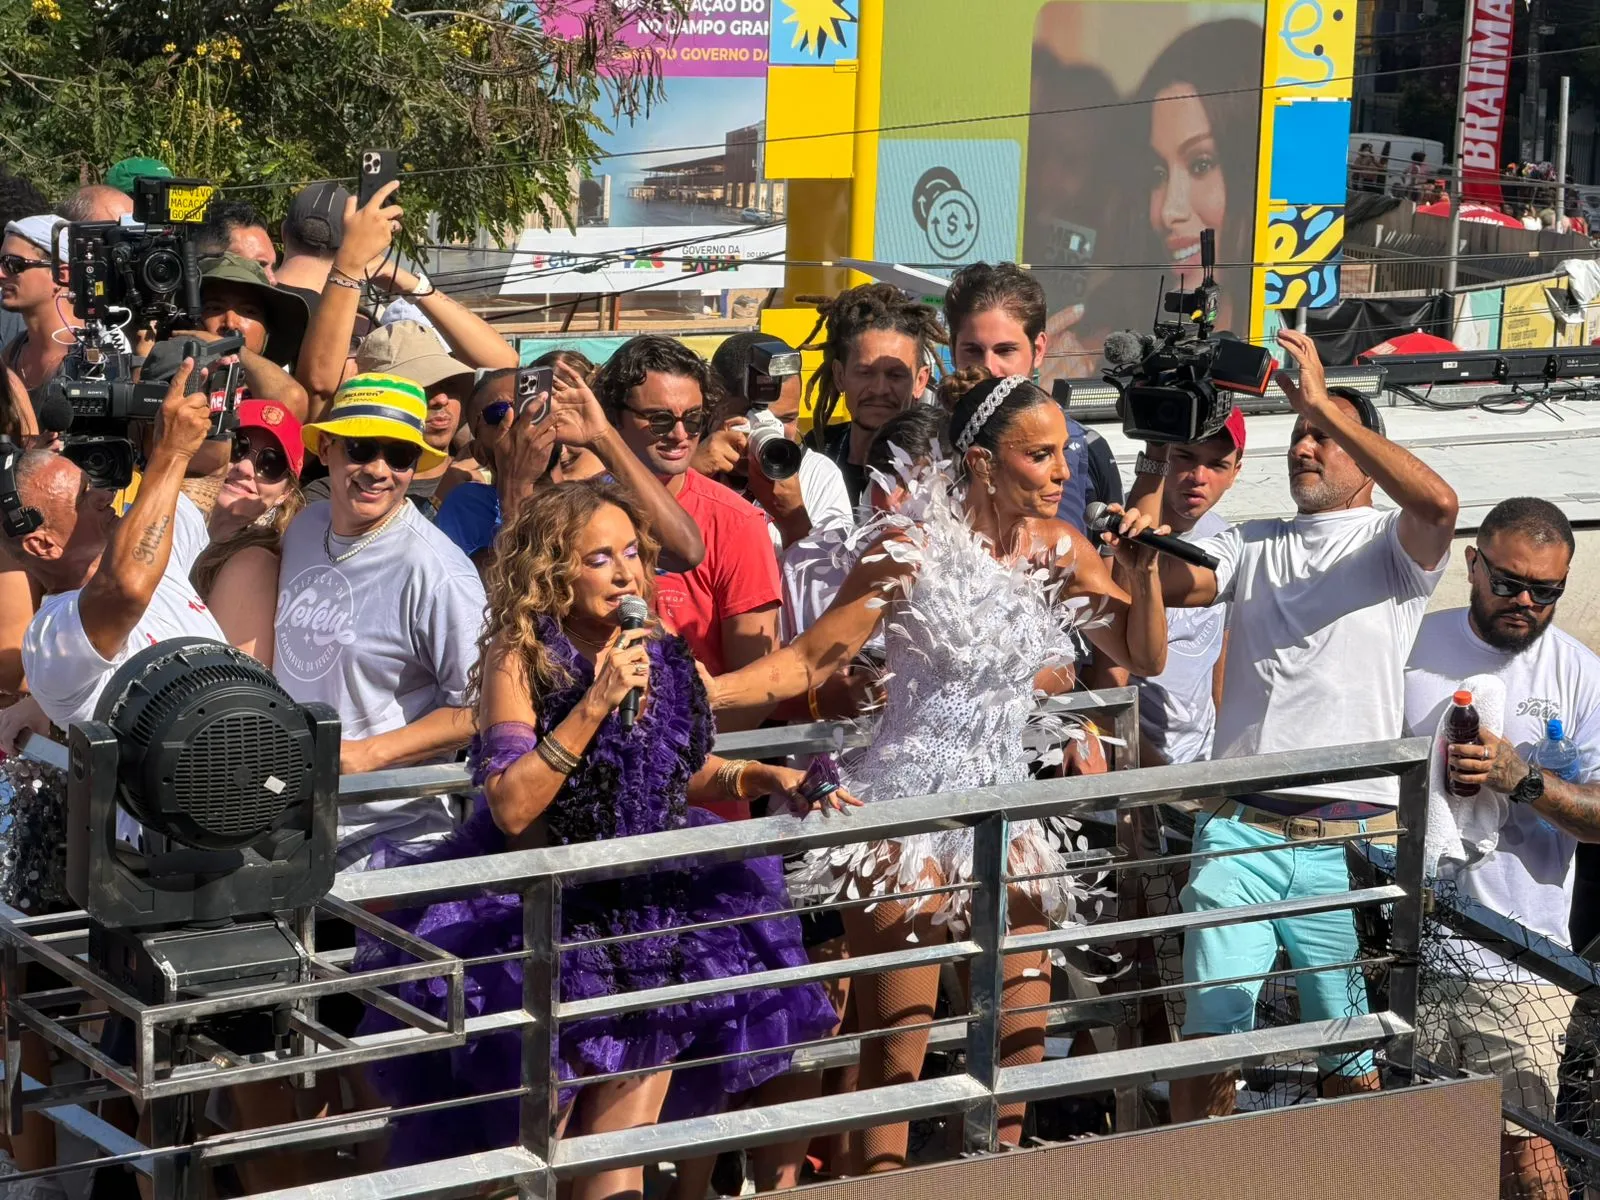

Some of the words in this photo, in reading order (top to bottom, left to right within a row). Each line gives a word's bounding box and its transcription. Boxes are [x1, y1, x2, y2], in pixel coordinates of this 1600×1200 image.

[740, 0, 765, 13] DO
[637, 19, 662, 34] NO
[665, 19, 726, 35] CAMPO
[680, 47, 750, 61] GOVERNO
[753, 48, 768, 62] DA
[1463, 0, 1513, 170] BRAHMA
[682, 245, 726, 255] GOVERNO
[728, 245, 741, 254] DA
